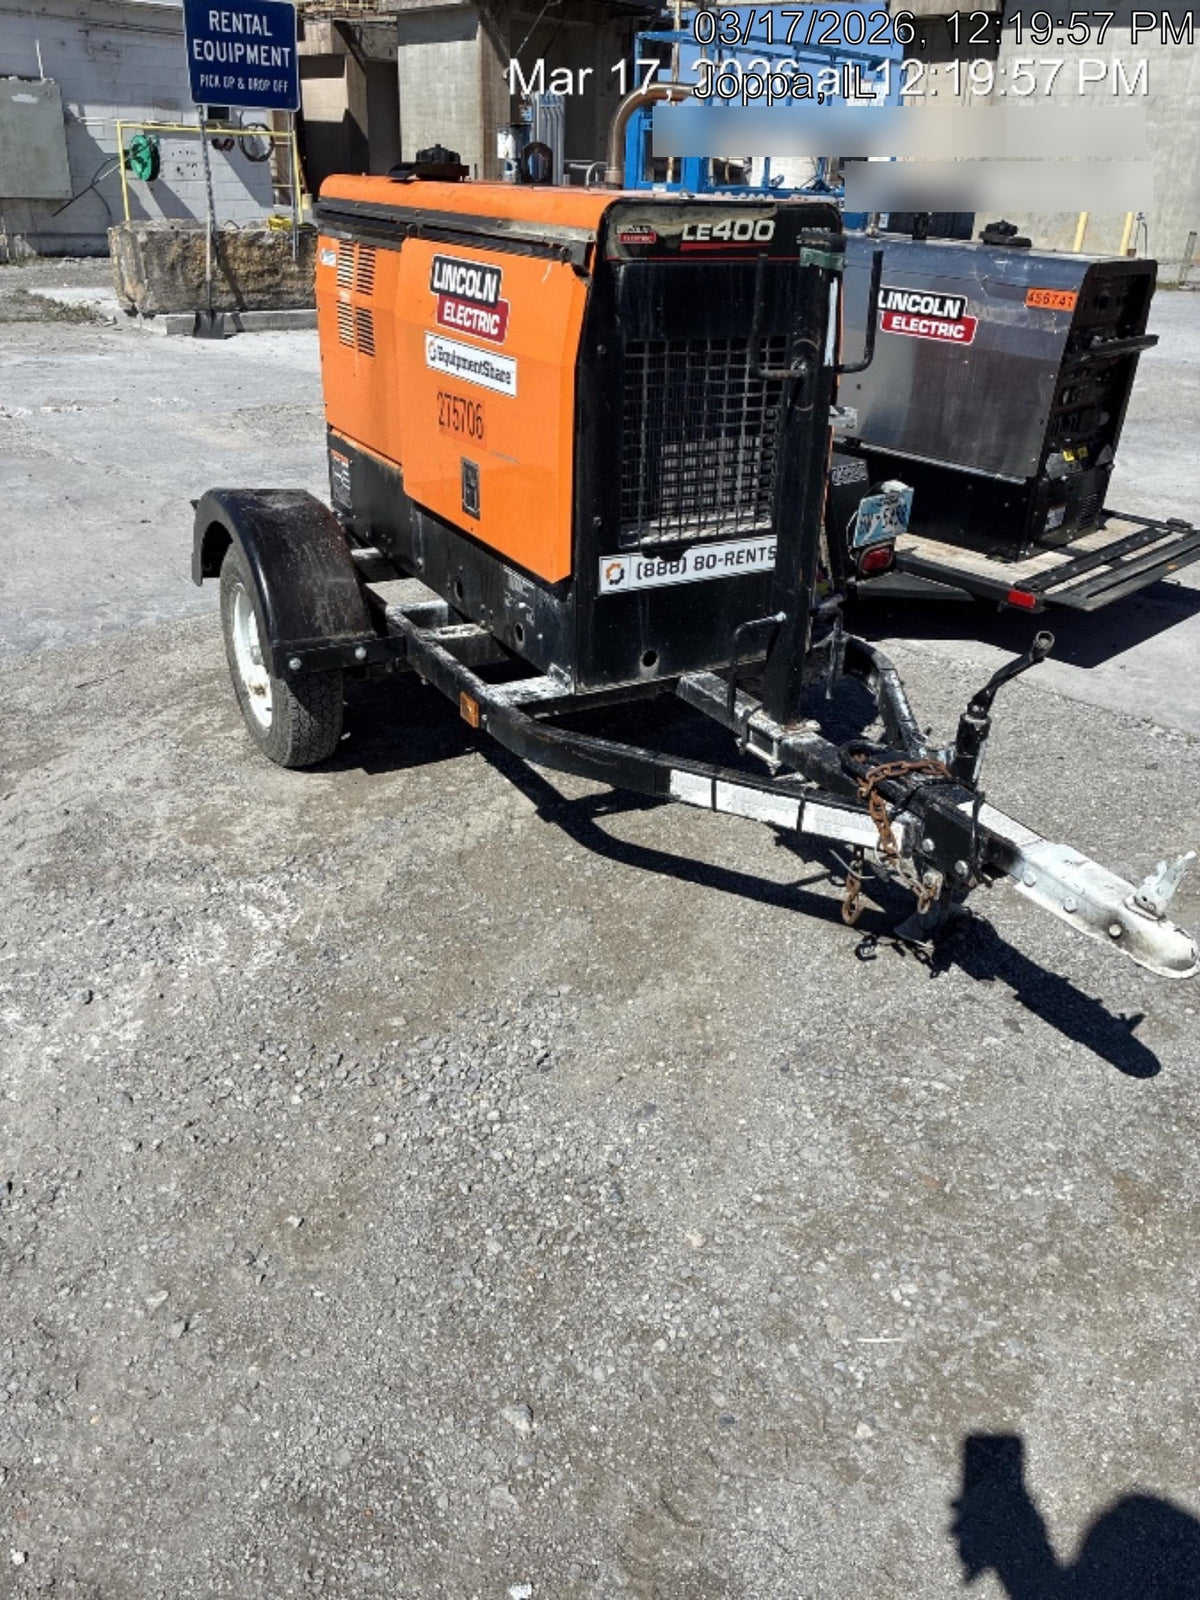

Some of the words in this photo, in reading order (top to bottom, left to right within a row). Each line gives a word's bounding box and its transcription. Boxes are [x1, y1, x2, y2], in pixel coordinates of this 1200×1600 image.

[208, 10, 273, 37] RENTAL
[193, 38, 291, 69] EQUIPMENT
[200, 74, 221, 89] PICK
[223, 75, 235, 89] UP
[237, 77, 246, 90] &
[248, 77, 271, 92] DROP
[273, 80, 289, 94] OFF
[682, 219, 776, 241] LE400
[433, 261, 498, 303] LINCOLN
[443, 300, 501, 335] ELECTRIC
[878, 290, 961, 319] LINCOLN
[891, 315, 967, 339] ELECTRIC
[437, 344, 512, 385] EquipmentShare
[437, 391, 485, 440] 275706
[636, 557, 687, 581] (888)
[694, 545, 778, 571] 80-RENTS
